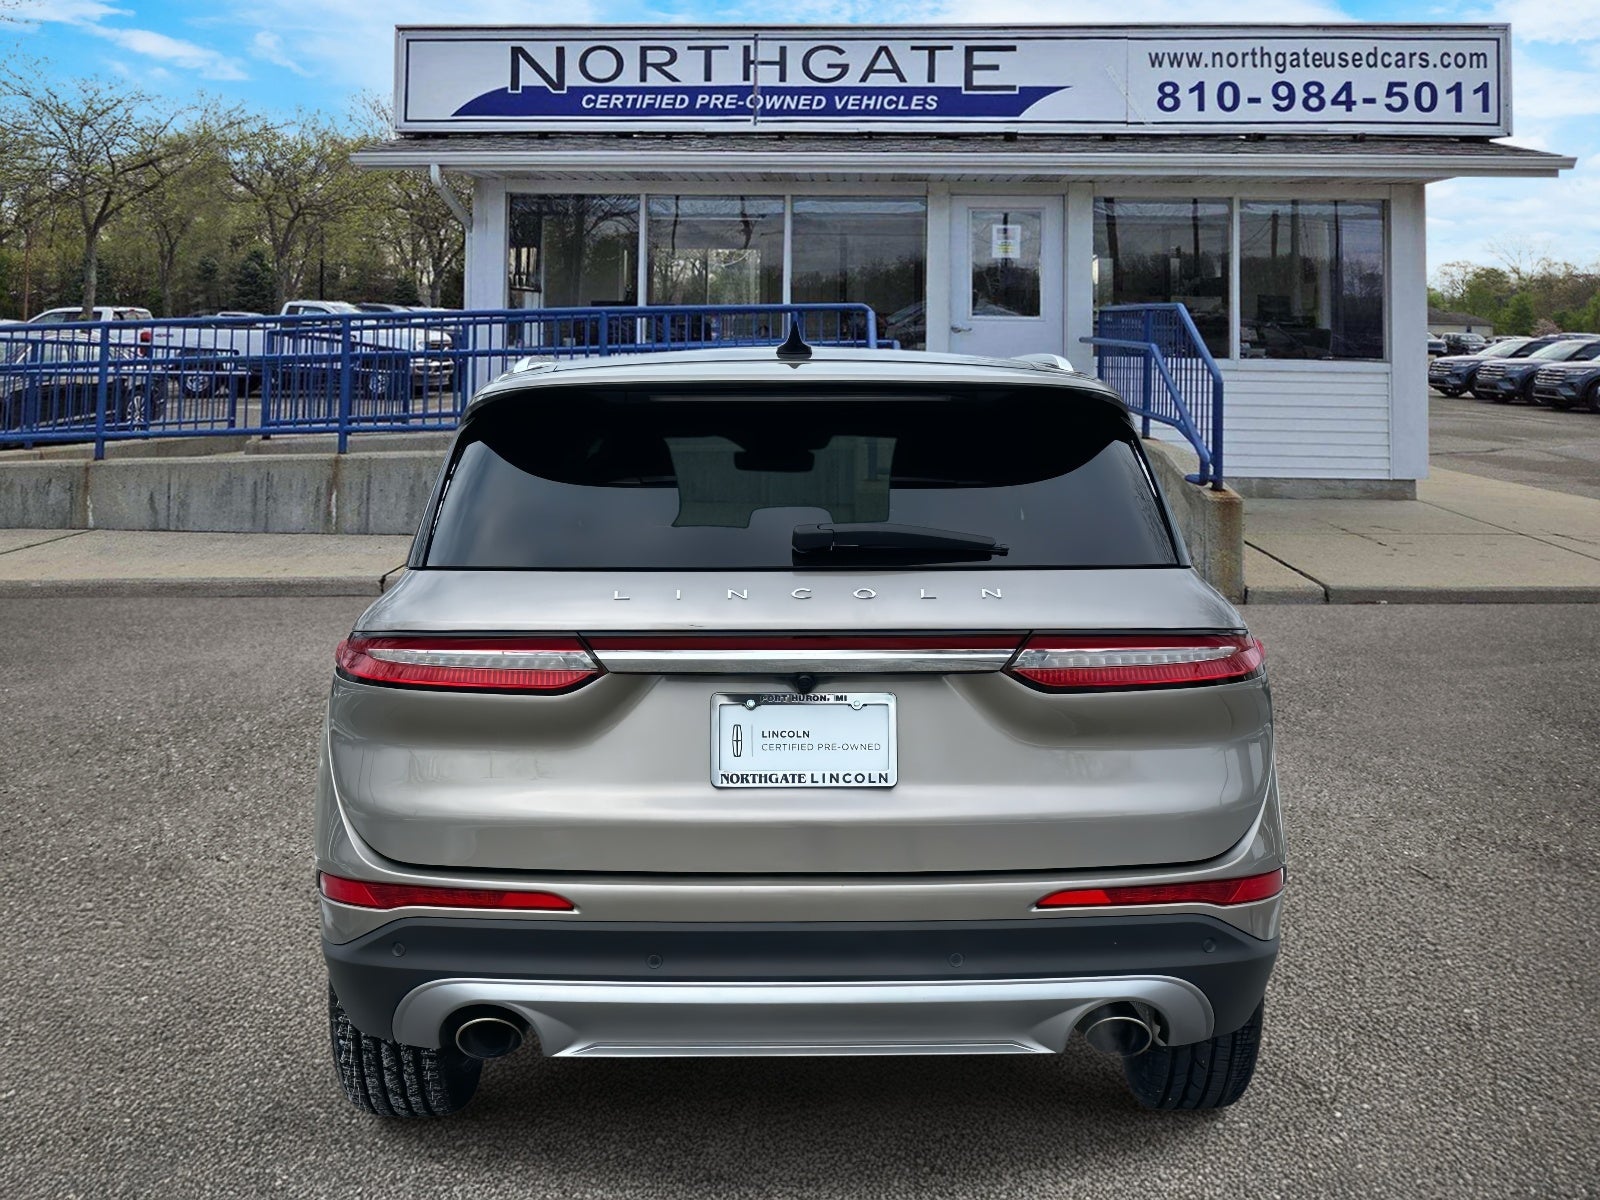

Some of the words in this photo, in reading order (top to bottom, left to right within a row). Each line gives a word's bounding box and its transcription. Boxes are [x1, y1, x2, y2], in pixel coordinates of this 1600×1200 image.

[1149, 46, 1488, 73] www.northgateusedcars.com
[510, 45, 1017, 91] NORTHGATE
[581, 94, 690, 109] CERTIFIED
[695, 94, 826, 110] PRE-OWNED
[834, 94, 938, 110] VEHICLES
[1156, 80, 1491, 113] 810-984-5011
[613, 588, 1003, 601] LINCOLN
[761, 730, 810, 738] LINCOLN
[761, 743, 814, 751] CERTIFIED
[817, 743, 881, 751] PRE-OWNED
[720, 773, 807, 785] NORTHGATE
[810, 773, 889, 784] LINCOLN
